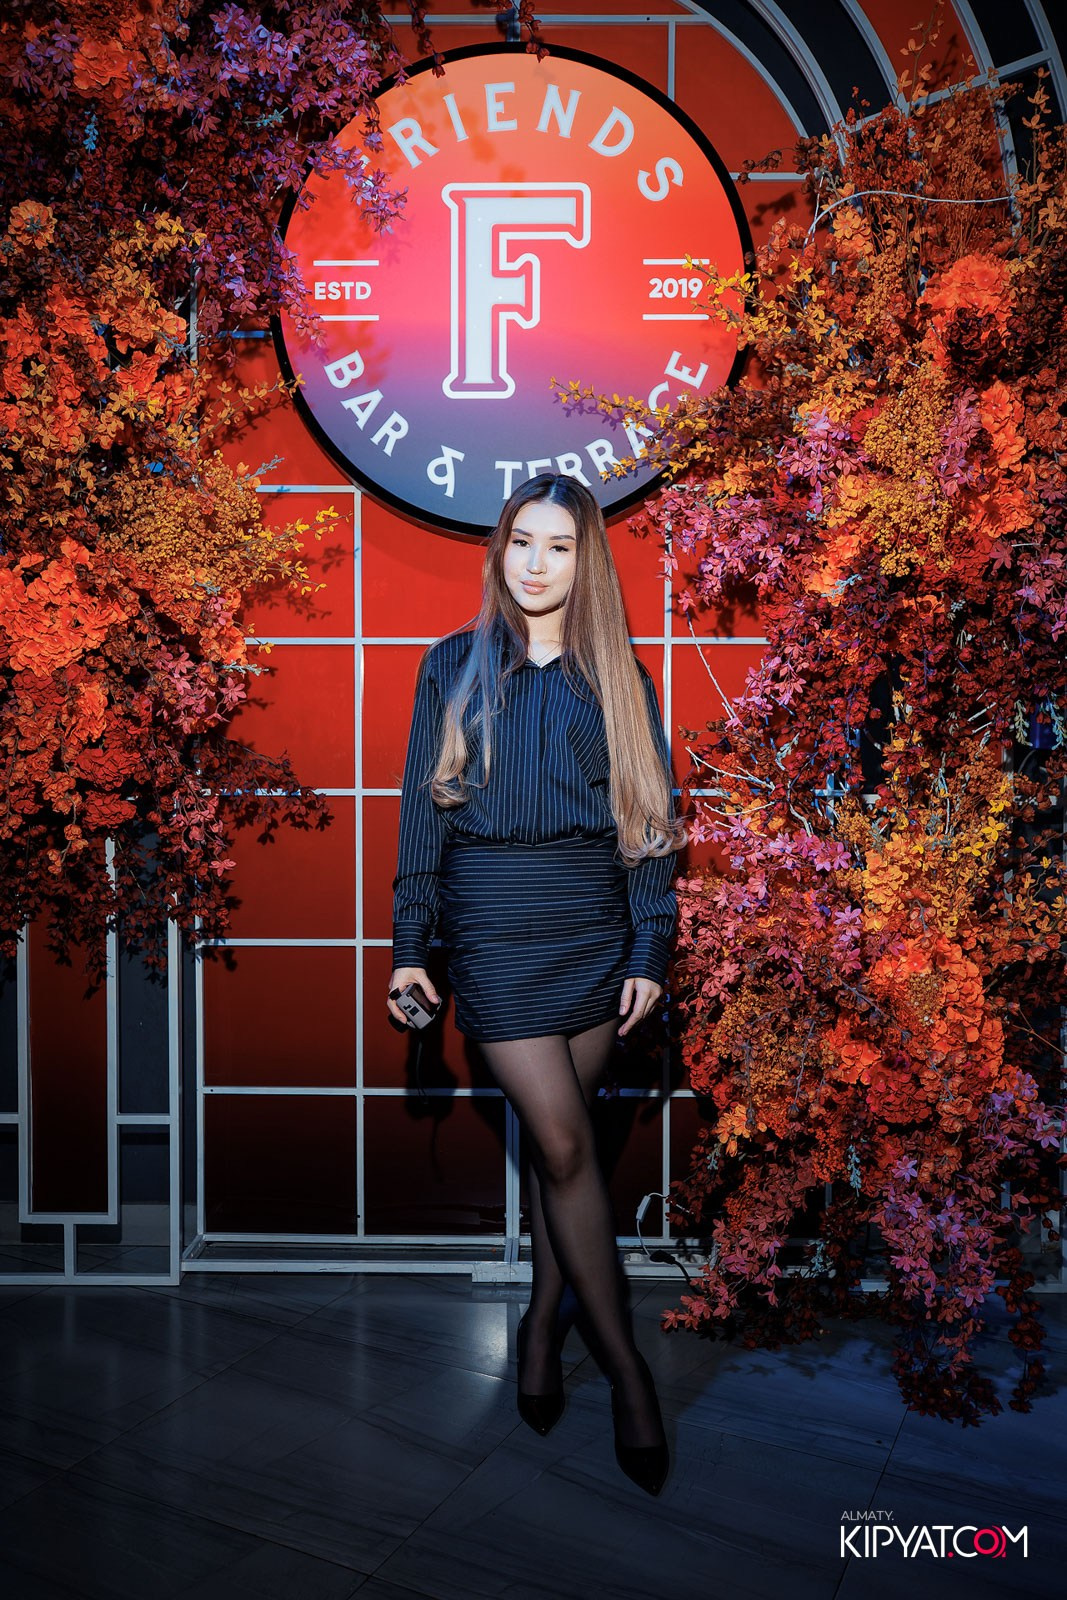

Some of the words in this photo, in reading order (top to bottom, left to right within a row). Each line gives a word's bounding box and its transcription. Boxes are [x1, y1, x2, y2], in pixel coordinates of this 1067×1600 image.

[357, 81, 684, 202] RIENDS
[314, 281, 372, 301] ESTD
[648, 277, 704, 300] 2019
[441, 182, 592, 400] F
[323, 350, 410, 456] BAR
